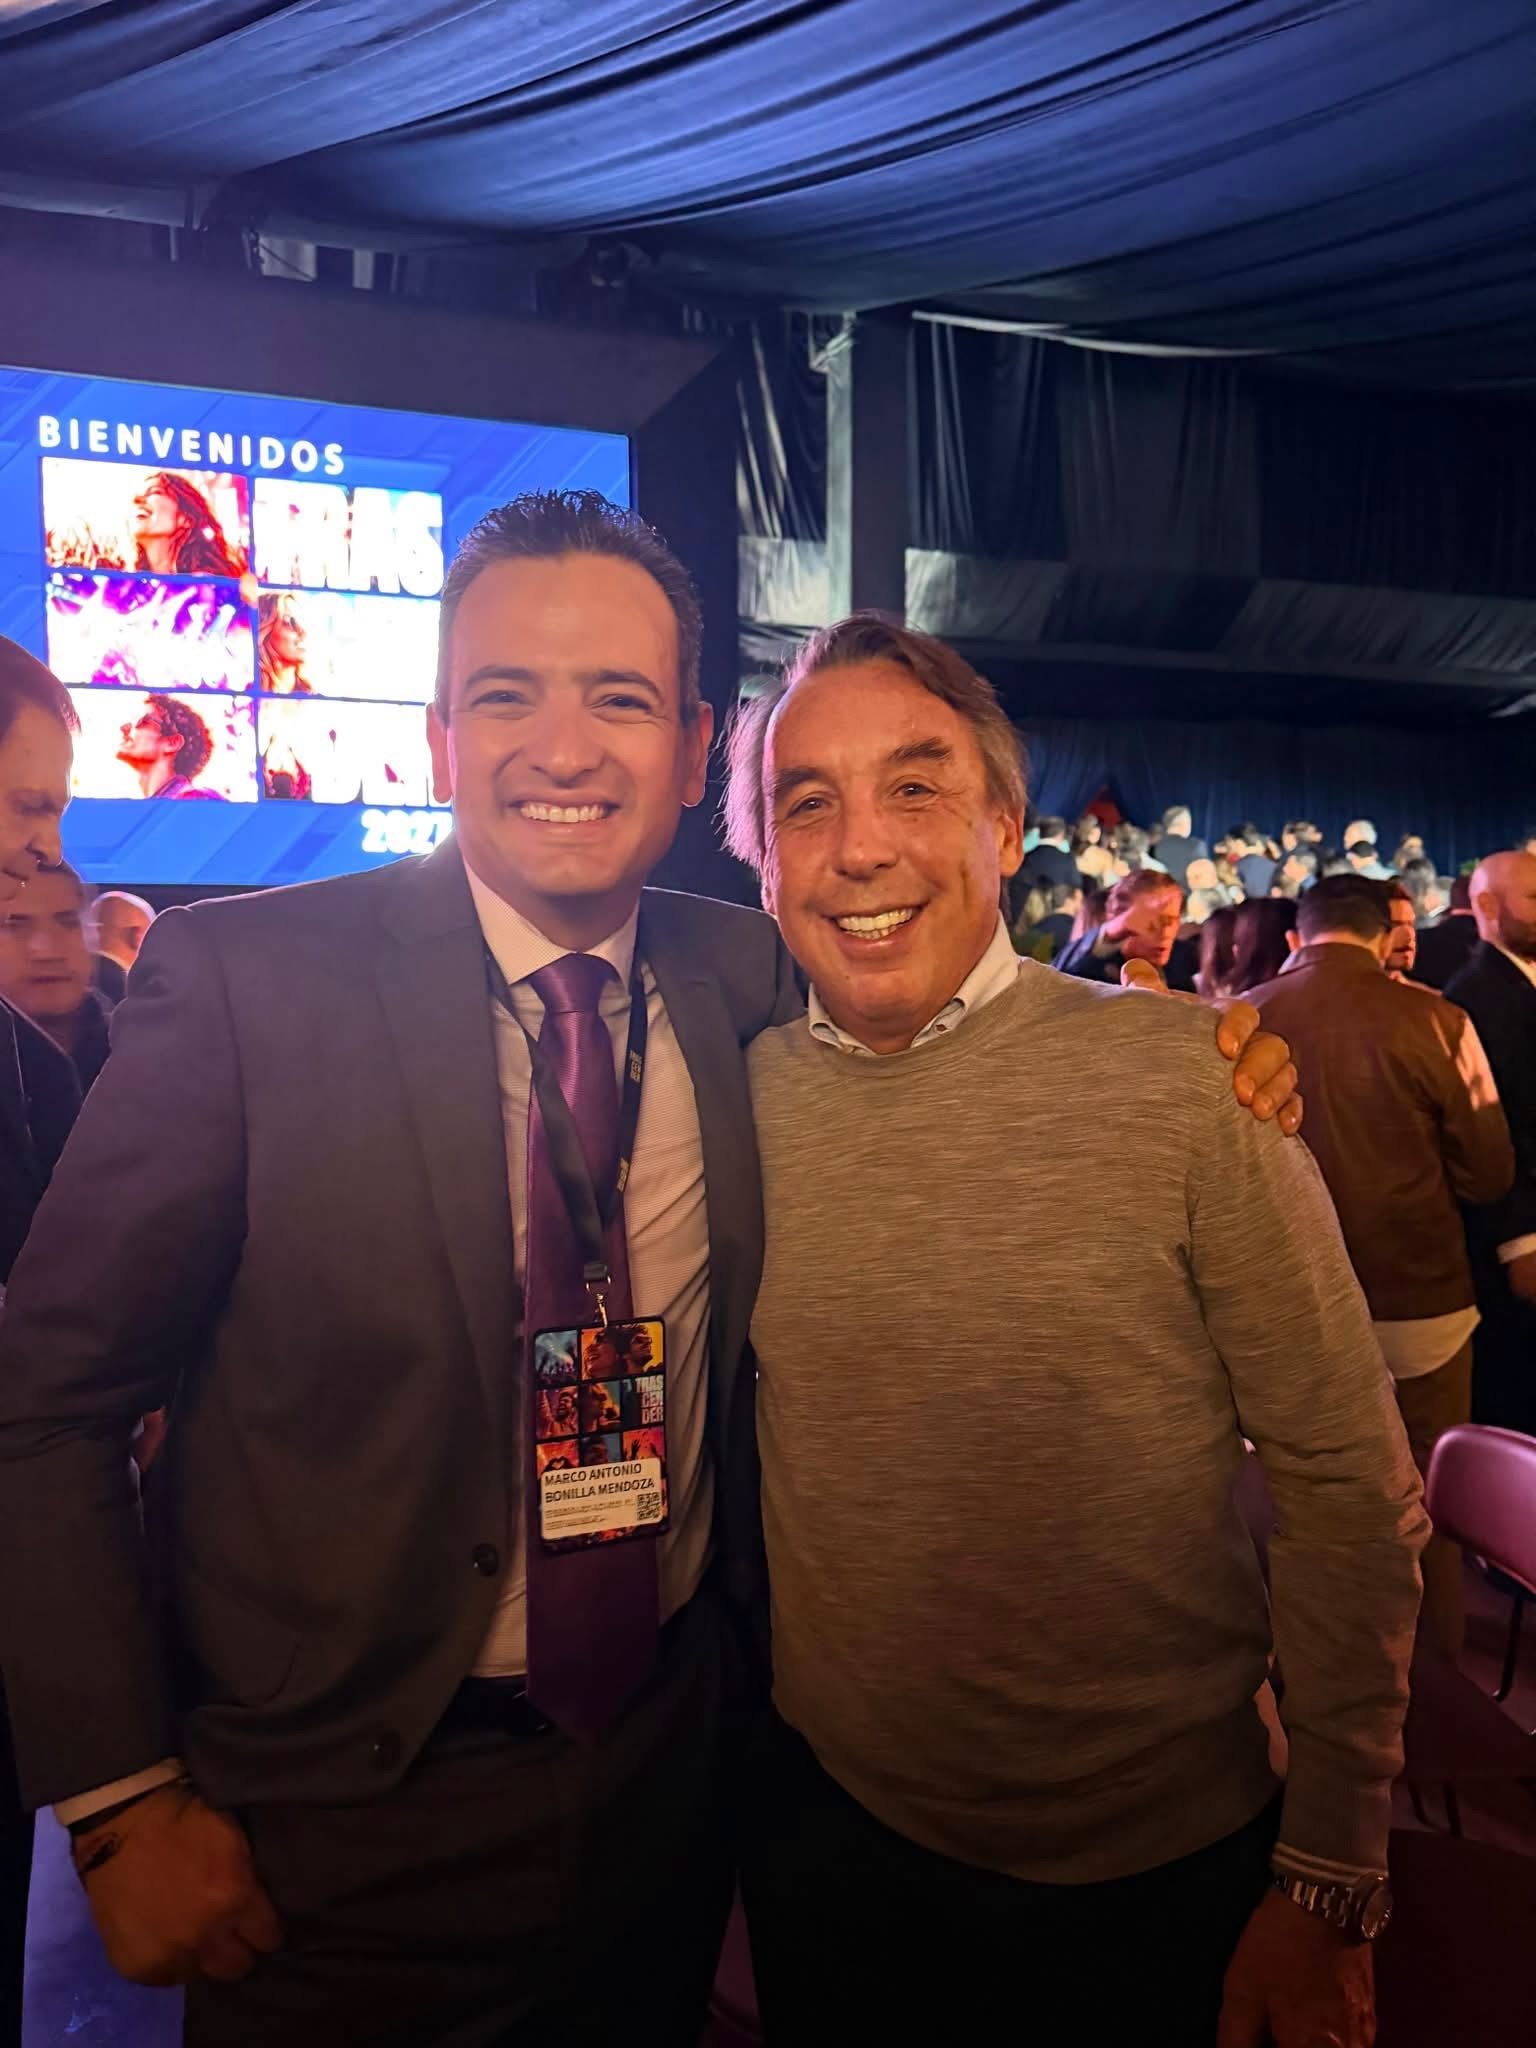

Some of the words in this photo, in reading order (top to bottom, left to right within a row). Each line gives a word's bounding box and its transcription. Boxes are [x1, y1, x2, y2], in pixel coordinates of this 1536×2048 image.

[39, 415, 345, 475] BIENVENIDOS
[545, 1470, 587, 1487] MARCO
[589, 1463, 642, 1481] ANTONIO
[545, 1486, 596, 1504] BONILLA
[598, 1478, 655, 1495] MENDOZA
